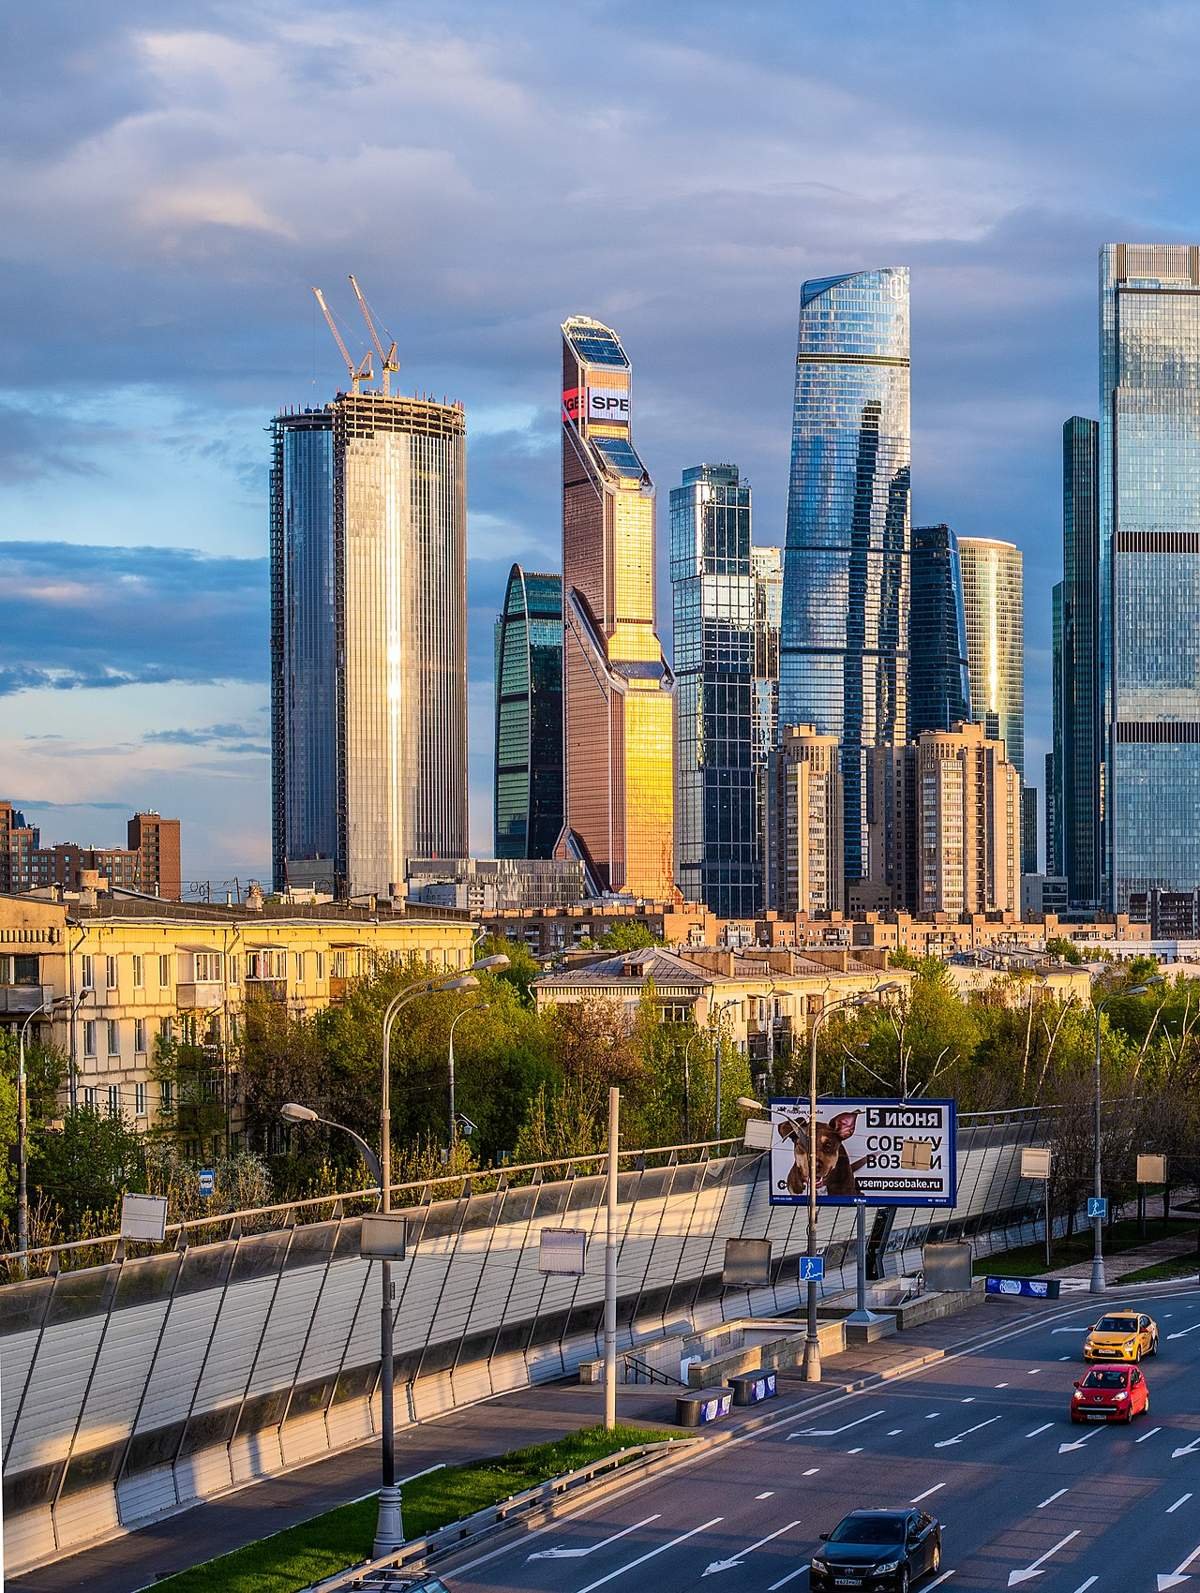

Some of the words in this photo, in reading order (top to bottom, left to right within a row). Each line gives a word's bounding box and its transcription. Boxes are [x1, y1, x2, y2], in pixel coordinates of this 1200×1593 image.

[870, 1109, 880, 1126] 5
[866, 1135, 942, 1151] СОБУ
[866, 1154, 942, 1169] ВОЗИ
[858, 1179, 940, 1189] vsemposobake.ru
